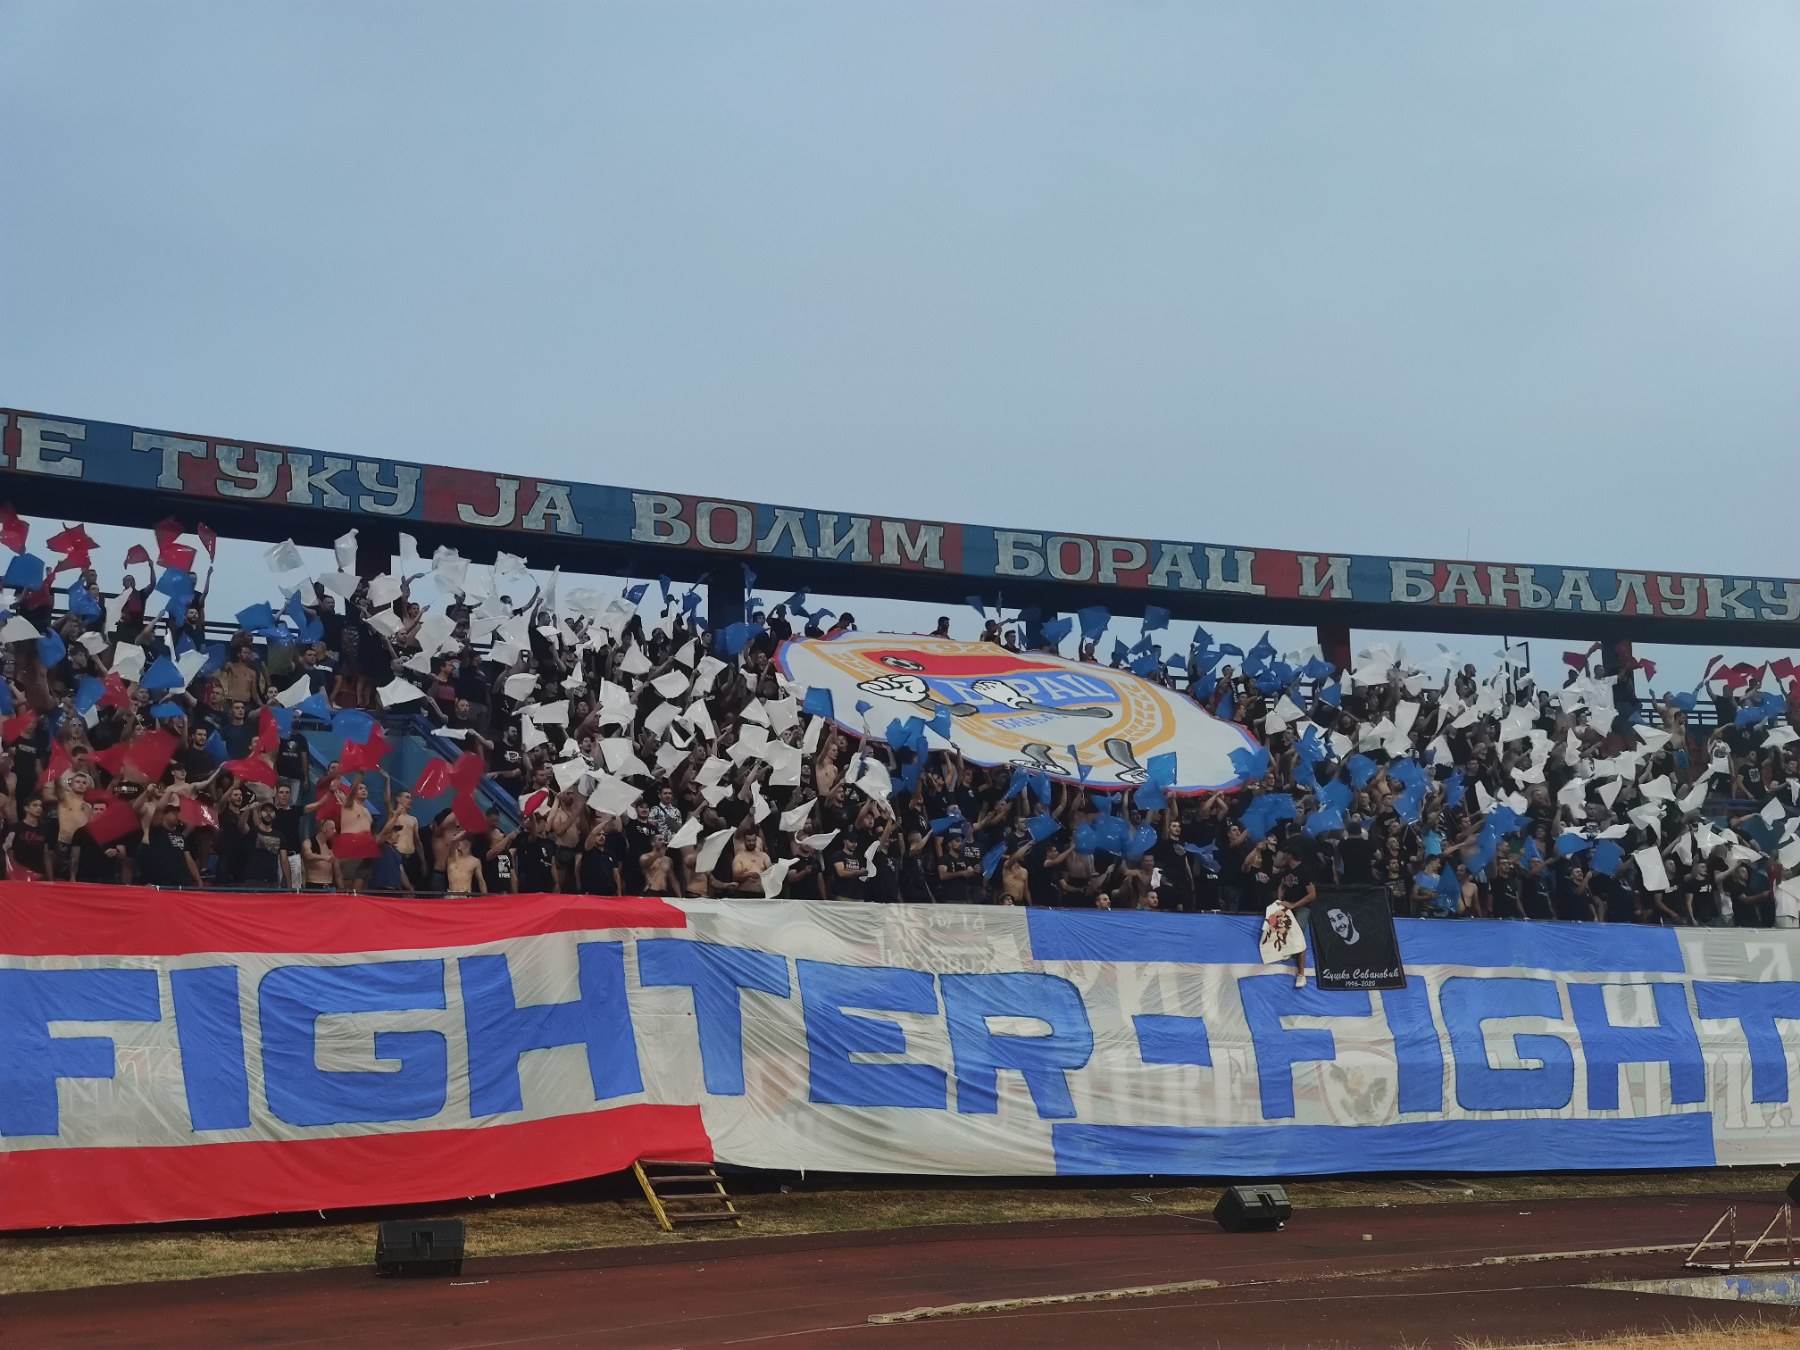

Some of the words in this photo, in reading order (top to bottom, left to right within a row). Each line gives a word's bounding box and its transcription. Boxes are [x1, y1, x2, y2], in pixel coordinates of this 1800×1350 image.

[0, 412, 87, 478] Е
[132, 431, 421, 516] ТУКУ
[457, 478, 583, 536] ЈА
[631, 491, 945, 570] ВОЛИМ
[994, 530, 1266, 597] БОРАЦ
[1297, 555, 1352, 600] И
[934, 674, 1115, 706] БРАЦ
